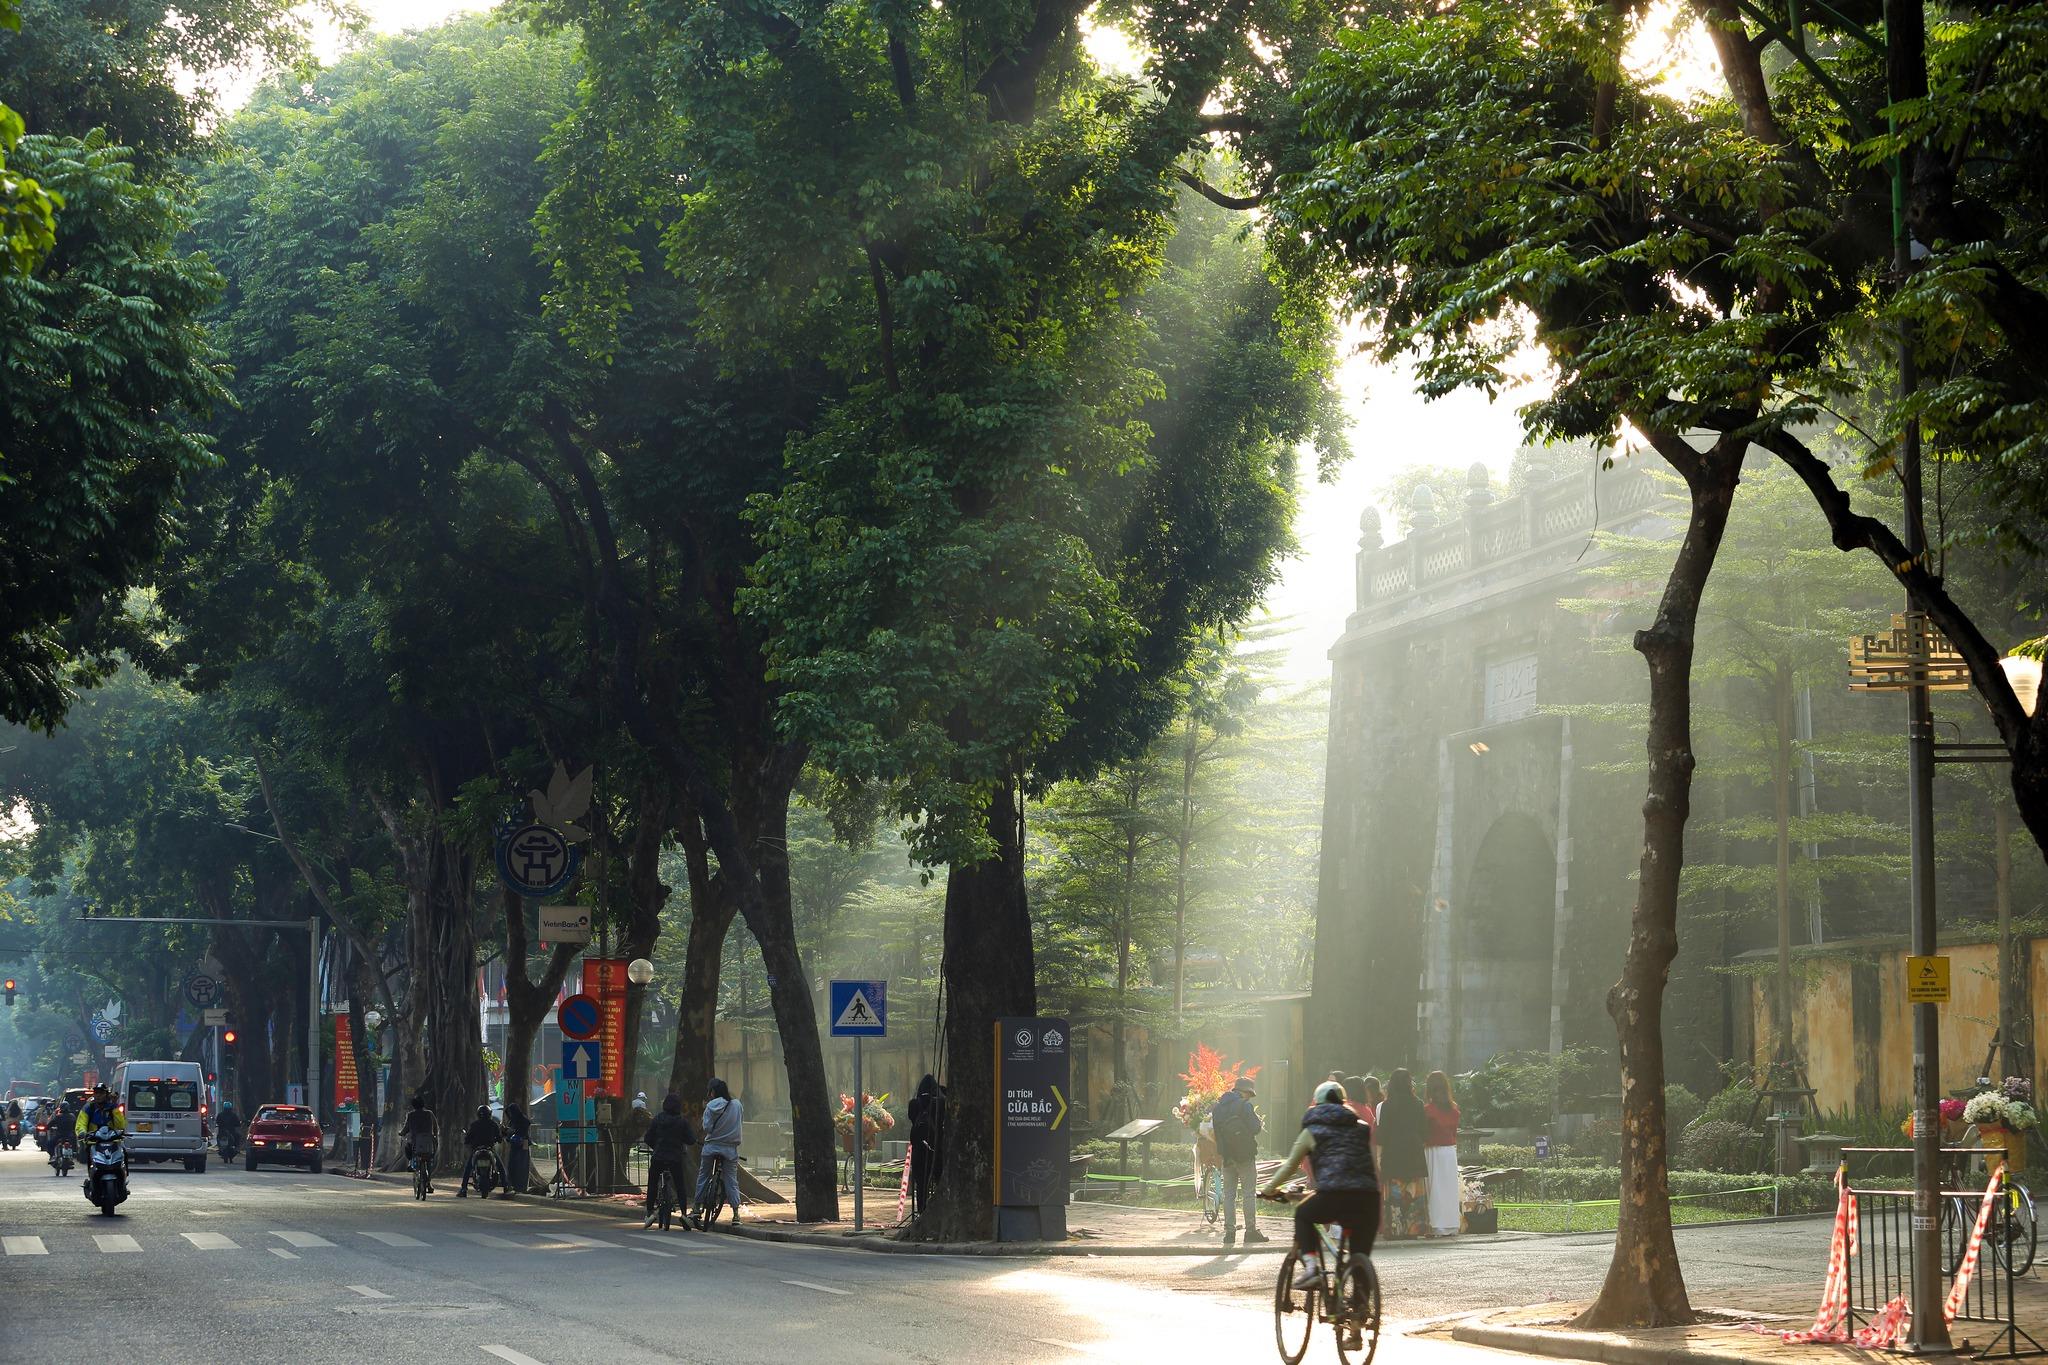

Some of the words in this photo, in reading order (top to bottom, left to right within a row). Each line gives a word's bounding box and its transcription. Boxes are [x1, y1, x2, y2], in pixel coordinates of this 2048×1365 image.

[543, 920, 579, 928] VietinBank
[1007, 1090, 1015, 1098] DI
[1016, 1088, 1033, 1098] TÍCH
[1007, 1099, 1029, 1113] CỬA
[1031, 1098, 1052, 1113] BẮC
